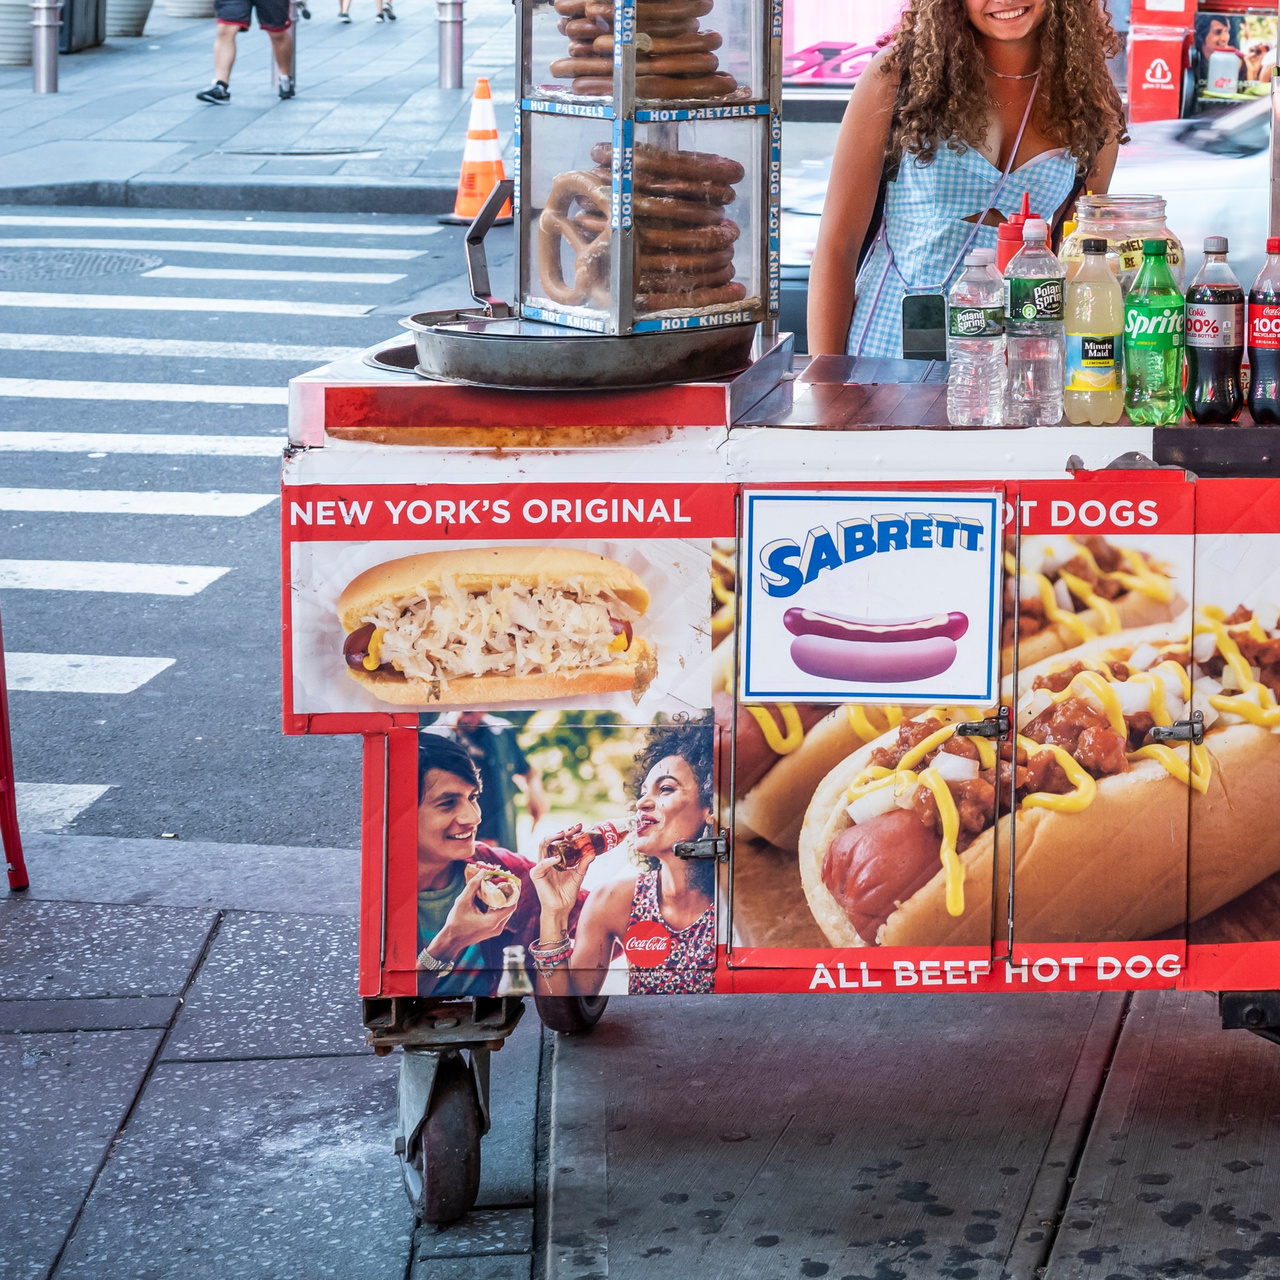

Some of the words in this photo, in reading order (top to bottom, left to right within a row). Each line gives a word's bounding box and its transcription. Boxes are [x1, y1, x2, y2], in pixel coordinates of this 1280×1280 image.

[622, 7, 633, 43] DOG
[555, 103, 604, 117] PRETZELS
[650, 109, 678, 120] HOT
[688, 105, 756, 119] PRETZELS
[770, 115, 781, 149] HOT
[769, 161, 780, 197] DOG
[621, 192, 632, 228] DOG
[769, 250, 779, 311] KNISHE
[566, 314, 603, 332] KNISHE
[661, 317, 689, 330] HOT
[699, 312, 750, 327] KNISHE
[956, 309, 986, 324] Poland
[956, 319, 986, 336] Spring
[1124, 309, 1184, 340] Sprite
[1186, 319, 1219, 333] 00%
[1084, 342, 1113, 351] Minute
[1088, 350, 1110, 358] Maid
[290, 499, 373, 526] NEW
[385, 499, 512, 525] YORK'S
[522, 498, 692, 523] ORIGINAL
[1002, 500, 1037, 527] OT
[1050, 499, 1159, 527] DOGS
[759, 511, 984, 598] SABRETT
[626, 936, 669, 951] Coca-Cola
[809, 961, 882, 990] ALL
[894, 959, 988, 985] BEEF
[1005, 956, 1084, 985] HOT
[1096, 953, 1182, 981] DOG
